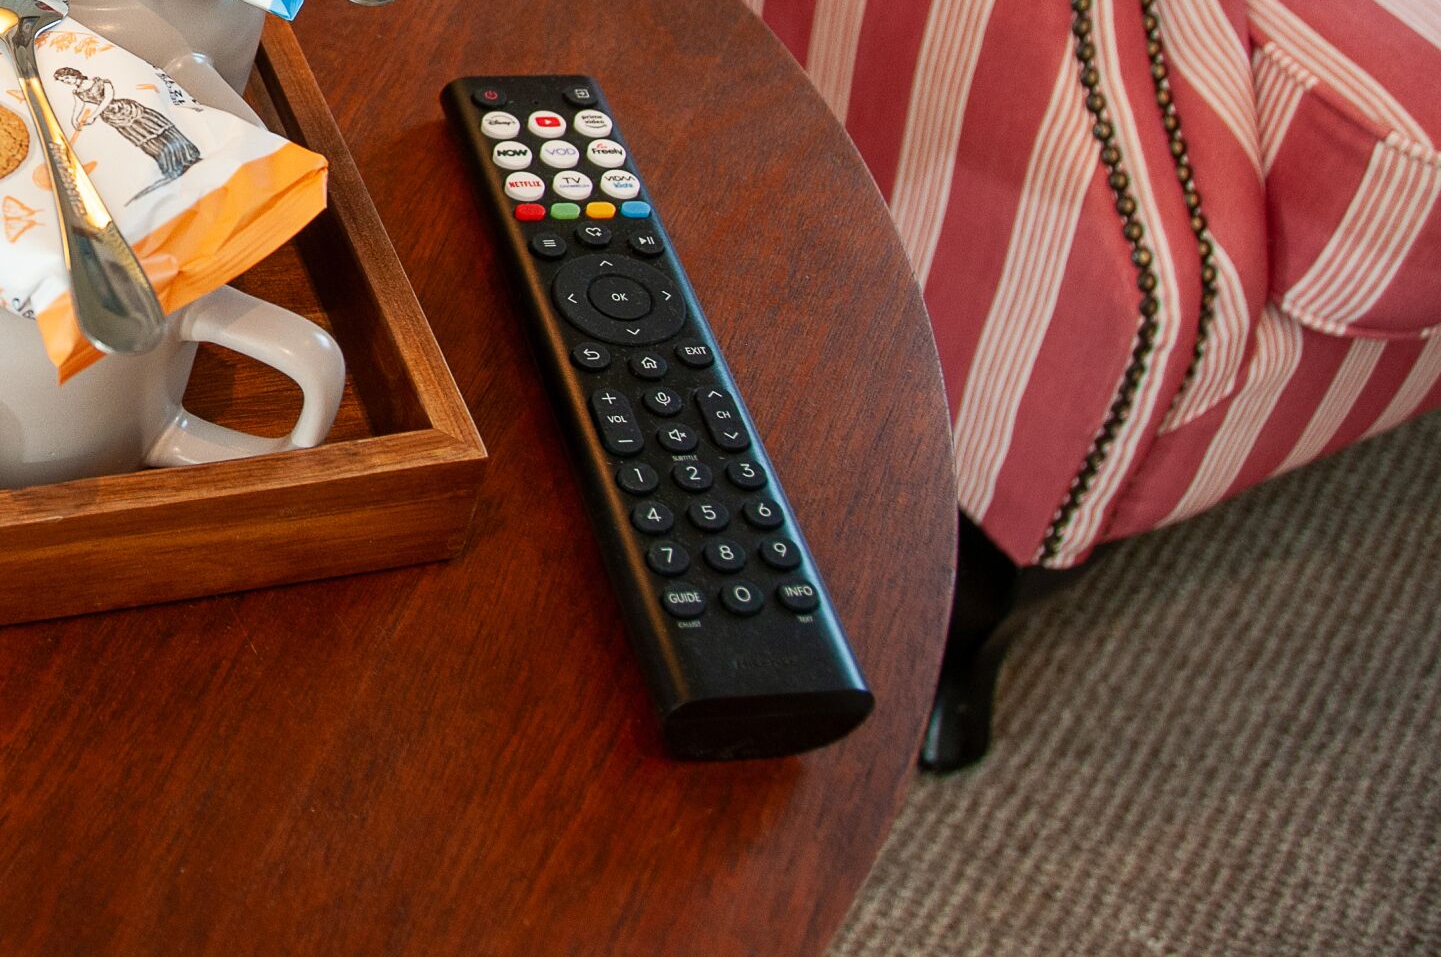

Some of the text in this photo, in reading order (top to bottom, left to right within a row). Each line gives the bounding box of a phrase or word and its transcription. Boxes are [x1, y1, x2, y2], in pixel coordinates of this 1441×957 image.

[497, 149, 528, 157] NOW
[545, 148, 576, 156] VOD
[591, 147, 623, 156] Freely
[611, 293, 628, 301] OK
[685, 346, 706, 356] EXIT
[607, 414, 627, 424] VOL
[716, 410, 731, 419] CH
[633, 468, 644, 483] 1
[686, 466, 701, 480] 2
[741, 463, 755, 478] 3
[646, 507, 662, 523] 4
[702, 505, 717, 520] 5
[758, 503, 772, 518] 6
[661, 548, 674, 563] 7
[720, 545, 734, 561] 8
[773, 542, 787, 558] 9
[668, 592, 702, 604] GUIDE
[735, 586, 751, 602] 0
[784, 585, 813, 597] INFO
